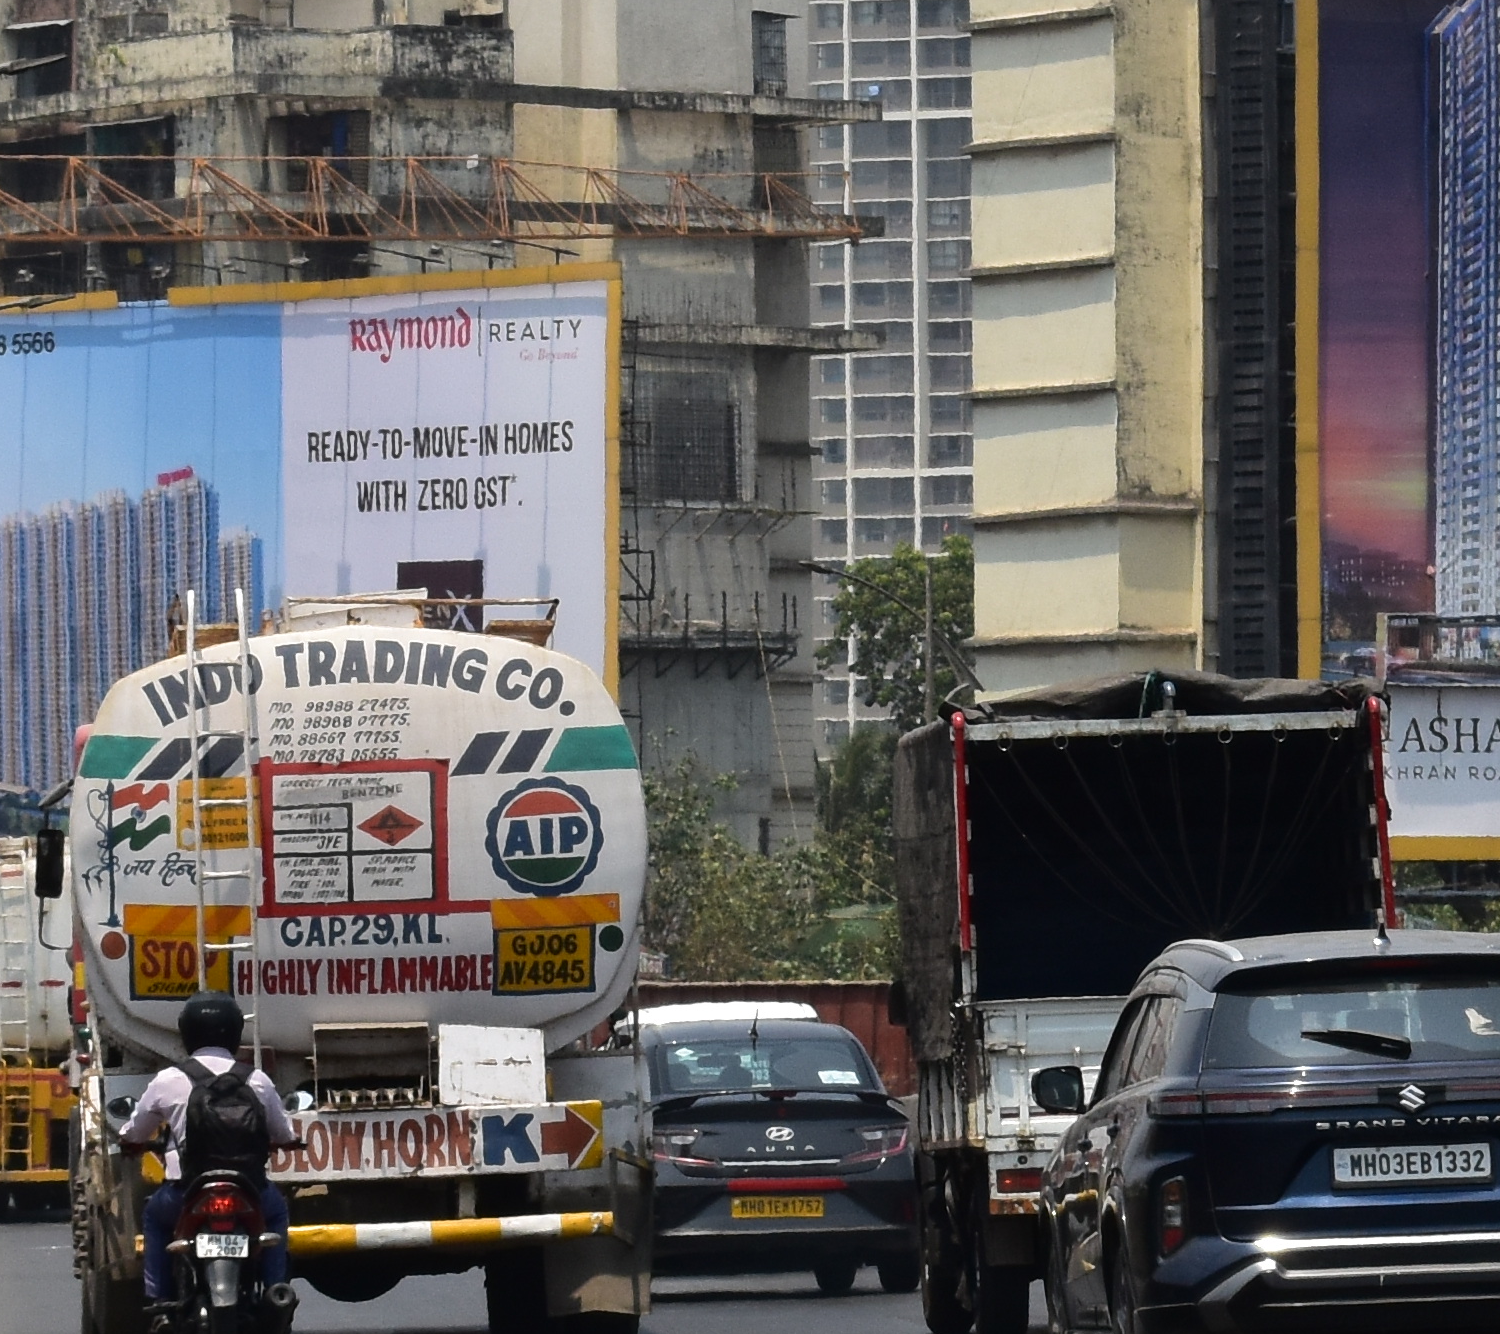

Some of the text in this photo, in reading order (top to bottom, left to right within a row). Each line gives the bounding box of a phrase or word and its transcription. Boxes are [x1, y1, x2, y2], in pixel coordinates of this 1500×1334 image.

[11, 331, 55, 355] 5566
[349, 306, 582, 363] Raymond REALTY
[307, 420, 574, 463] READY-TO-MOVE-IN HOMES
[357, 477, 468, 512] WITH ZERO
[274, 639, 489, 694] TRADING
[495, 657, 576, 717] CO.
[503, 815, 588, 857] AIP
[238, 954, 494, 996] HGHLY INFLAMMABLE
[1316, 1118, 1406, 1131] GRAND
[746, 1144, 815, 1153] AURA
[1349, 1149, 1486, 1177] MH03EB1332
